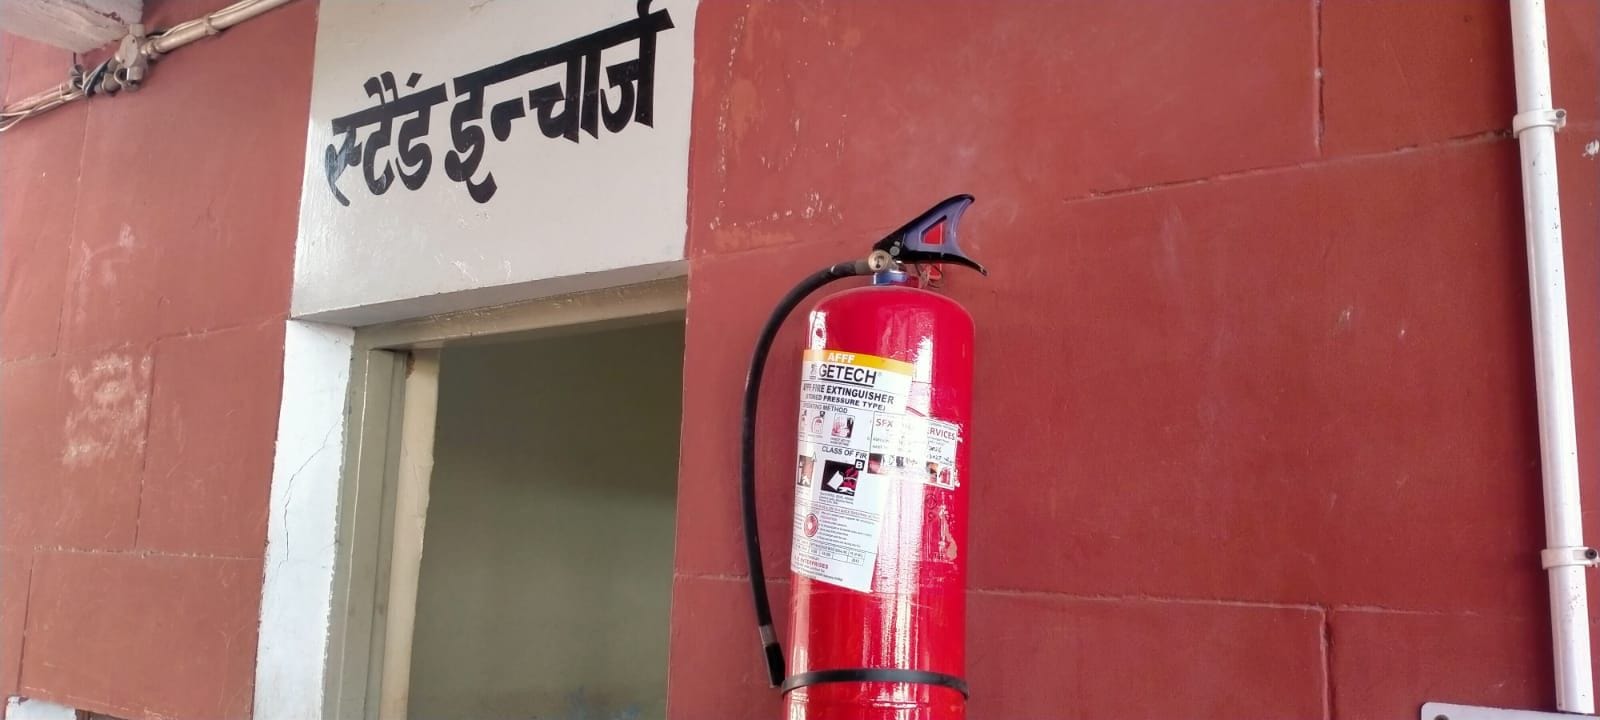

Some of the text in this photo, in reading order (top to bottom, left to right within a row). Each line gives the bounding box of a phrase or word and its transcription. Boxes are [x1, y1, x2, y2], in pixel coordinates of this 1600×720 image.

[325, 71, 448, 207] स्टैंड
[827, 352, 855, 364] AFFF
[819, 363, 877, 385] GETECH
[823, 395, 860, 407] PRESSURE
[826, 385, 895, 405] EXTINGUISHER
[926, 427, 956, 441] RVICES
[821, 446, 842, 455] CLASS
